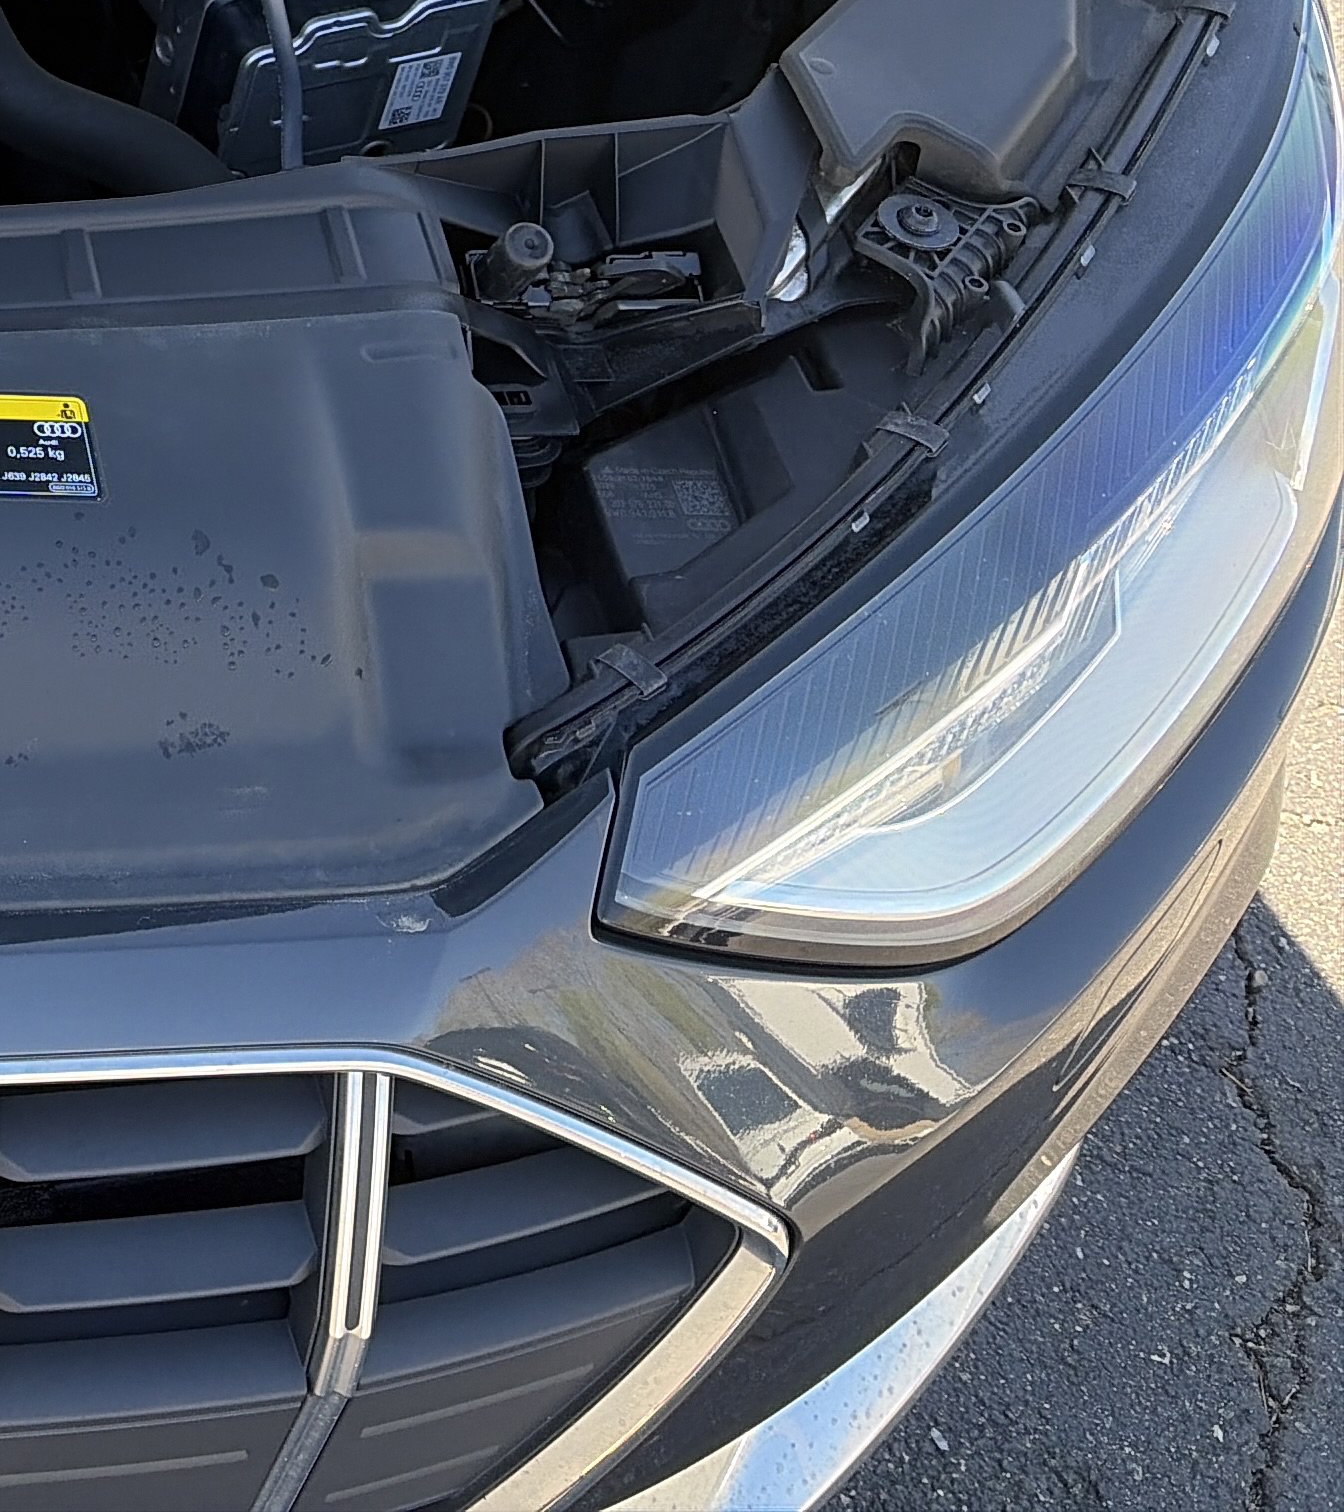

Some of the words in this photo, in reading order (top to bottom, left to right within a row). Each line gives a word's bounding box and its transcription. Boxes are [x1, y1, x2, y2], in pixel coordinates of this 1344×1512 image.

[7, 445, 45, 459] 0,525
[47, 446, 65, 461] kg
[28, 471, 60, 482] J2842
